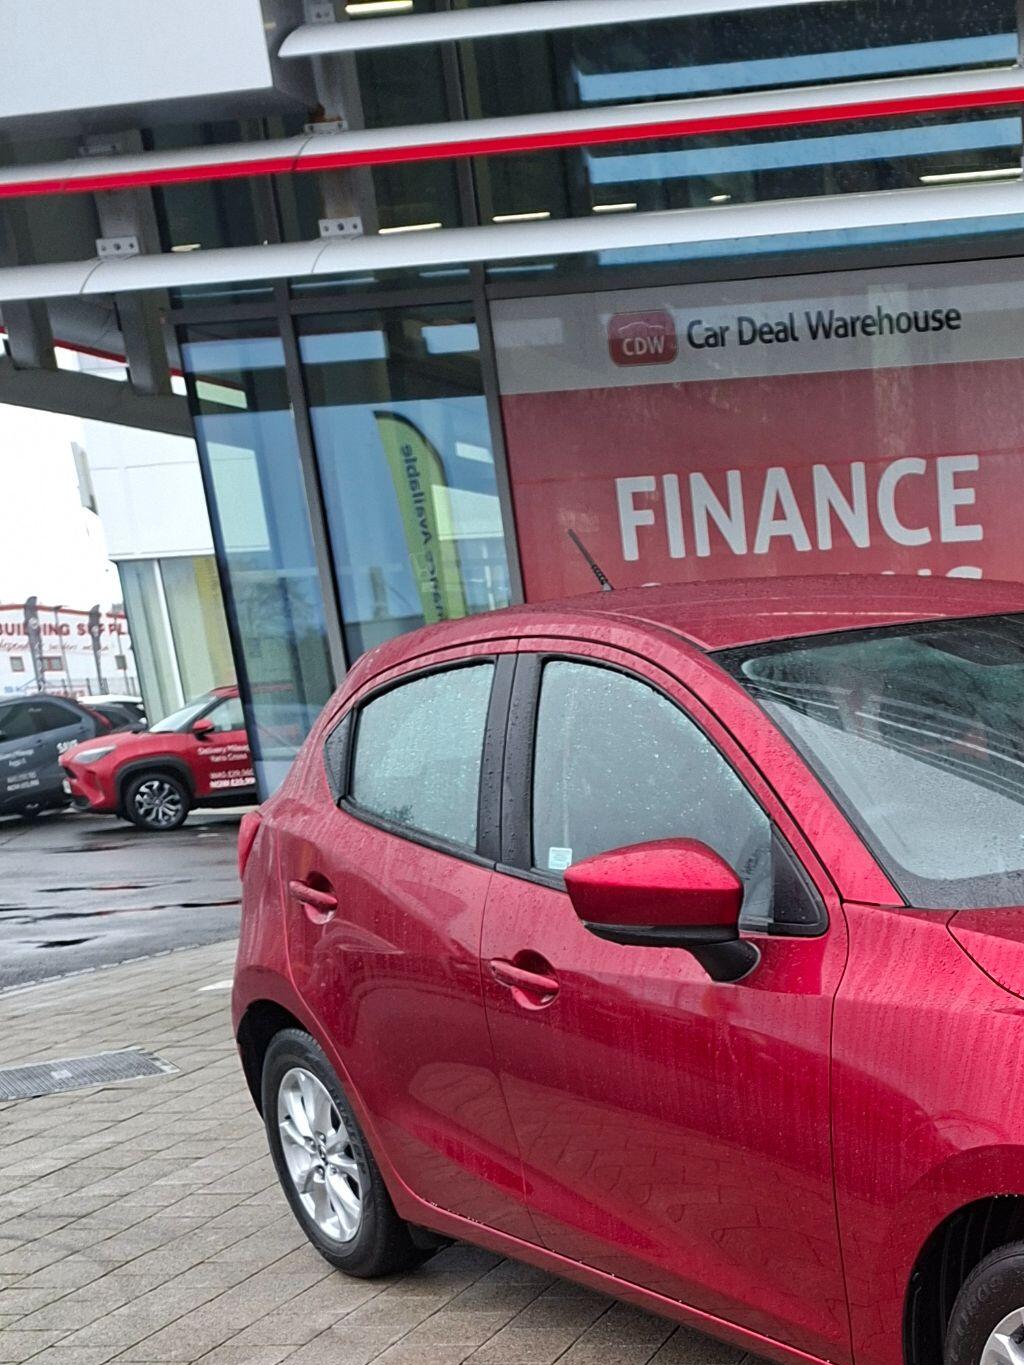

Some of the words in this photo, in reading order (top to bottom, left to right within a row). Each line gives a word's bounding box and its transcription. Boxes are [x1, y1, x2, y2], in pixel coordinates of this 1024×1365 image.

[686, 319, 731, 350] Car
[737, 312, 799, 347] Deal
[804, 305, 962, 340] Warehouse
[622, 335, 665, 357] CDW
[614, 453, 984, 562] FINANCE
[0, 622, 70, 636] UILING
